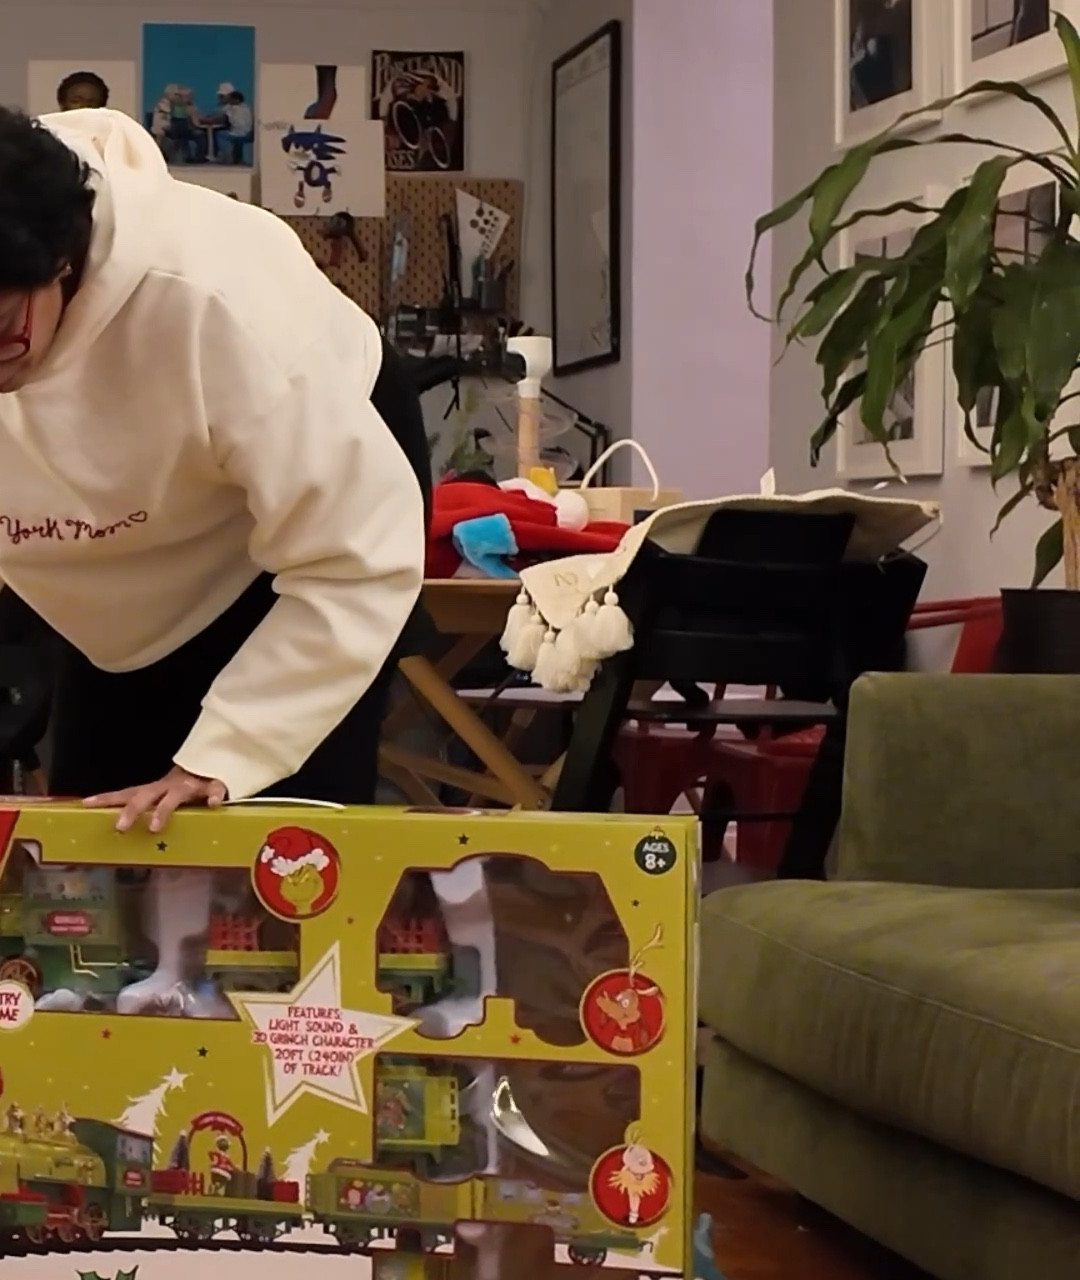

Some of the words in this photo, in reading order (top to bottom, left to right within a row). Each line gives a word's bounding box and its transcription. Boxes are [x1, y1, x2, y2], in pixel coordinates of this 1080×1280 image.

[642, 841, 670, 853] AGES
[644, 853, 667, 870] 8+
[306, 1021, 344, 1033] SOUND
[348, 1023, 358, 1035] &
[270, 1032, 309, 1046] GRINCH
[311, 1035, 374, 1048] CHARACTER
[283, 1062, 297, 1075] OF
[302, 1063, 343, 1076] TRACK!
